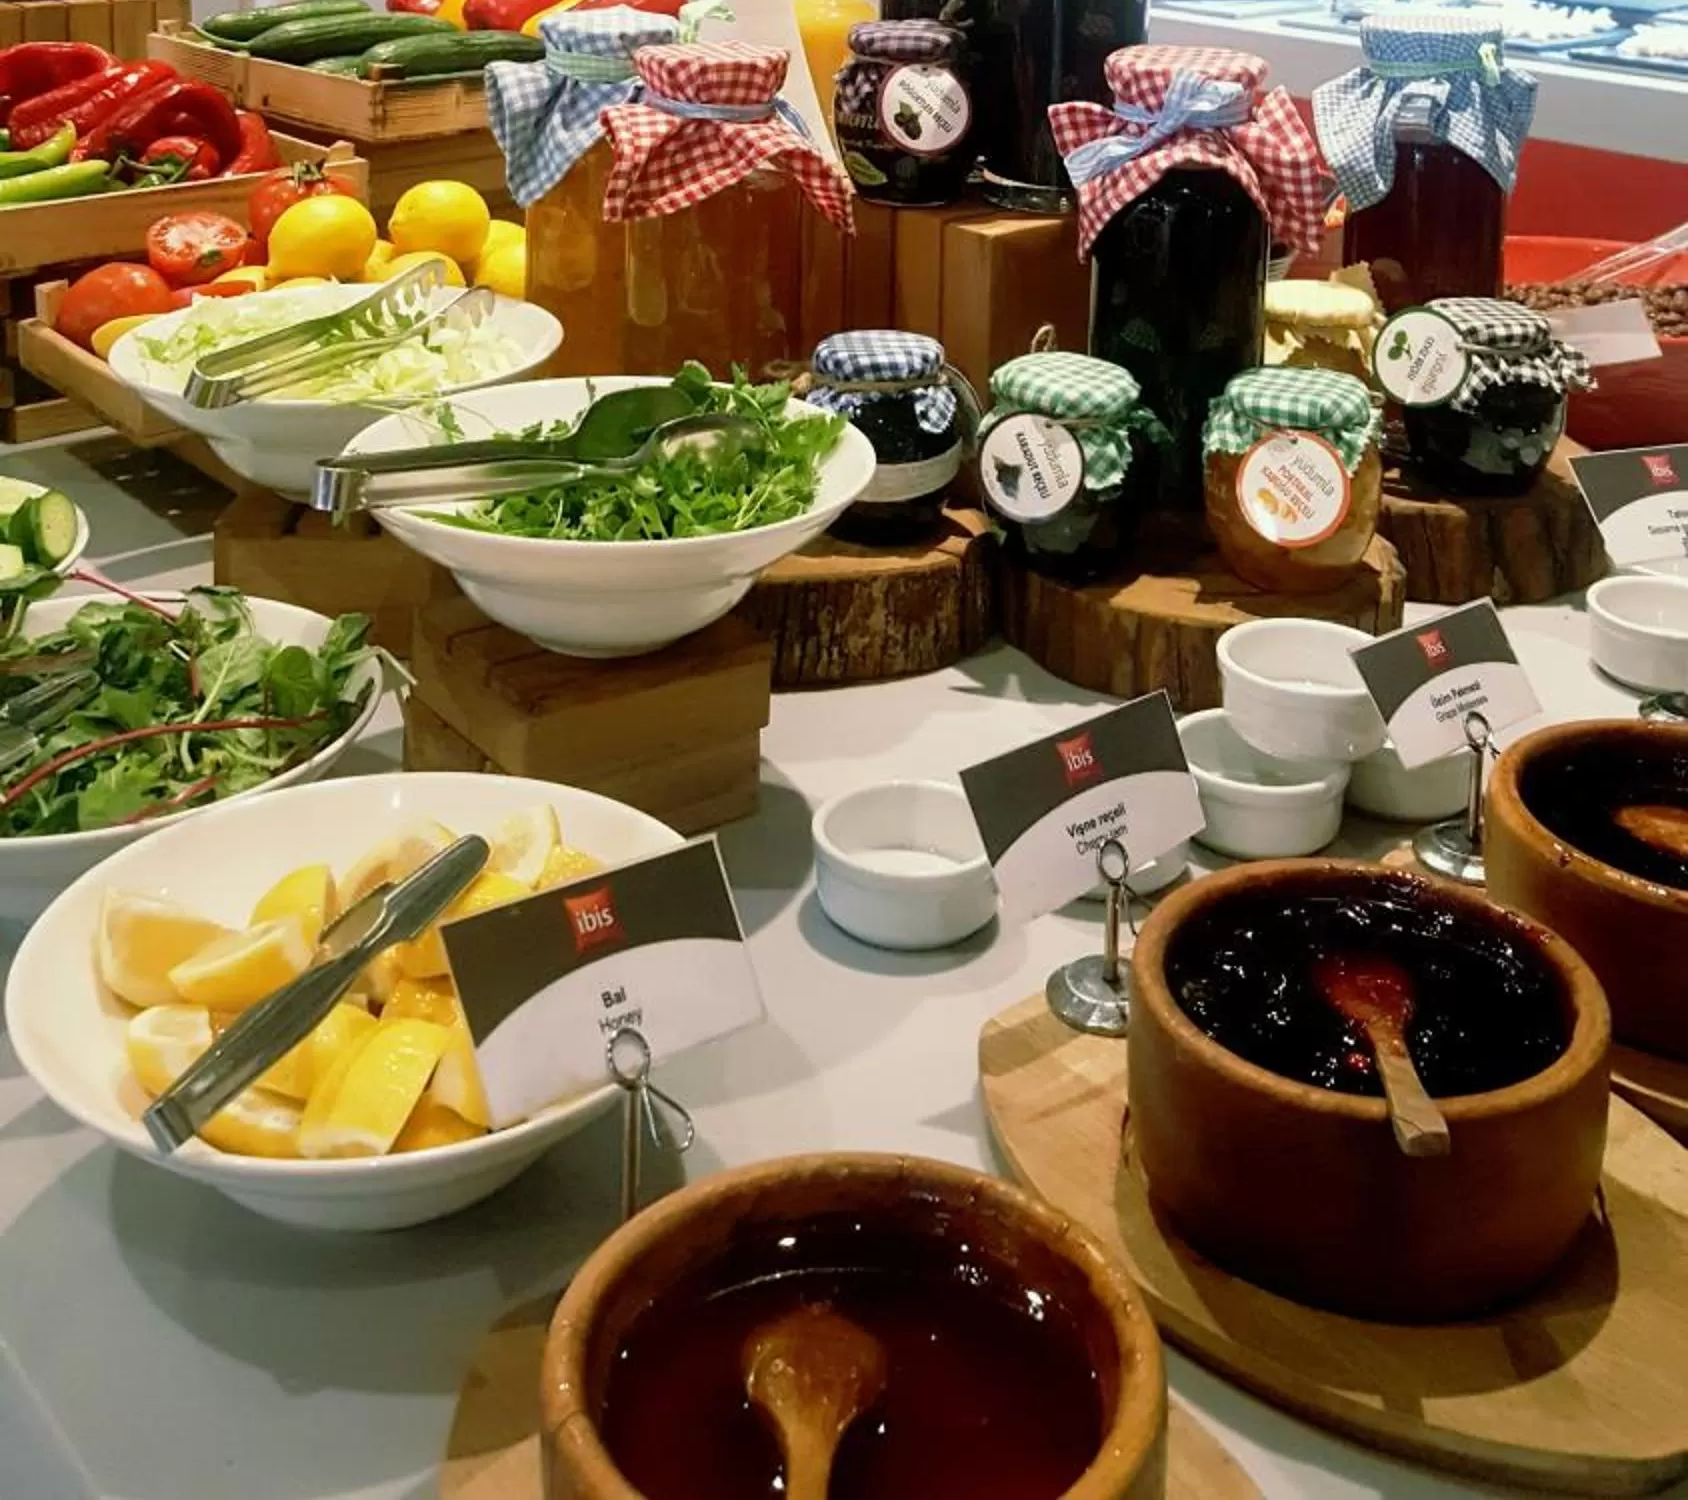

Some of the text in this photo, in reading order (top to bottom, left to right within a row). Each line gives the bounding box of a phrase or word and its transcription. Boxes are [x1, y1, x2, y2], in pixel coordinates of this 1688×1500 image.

[1066, 745, 1096, 772] ibis
[575, 905, 615, 935] ibis
[601, 985, 627, 1009] Bal
[598, 1007, 643, 1034] Honey
